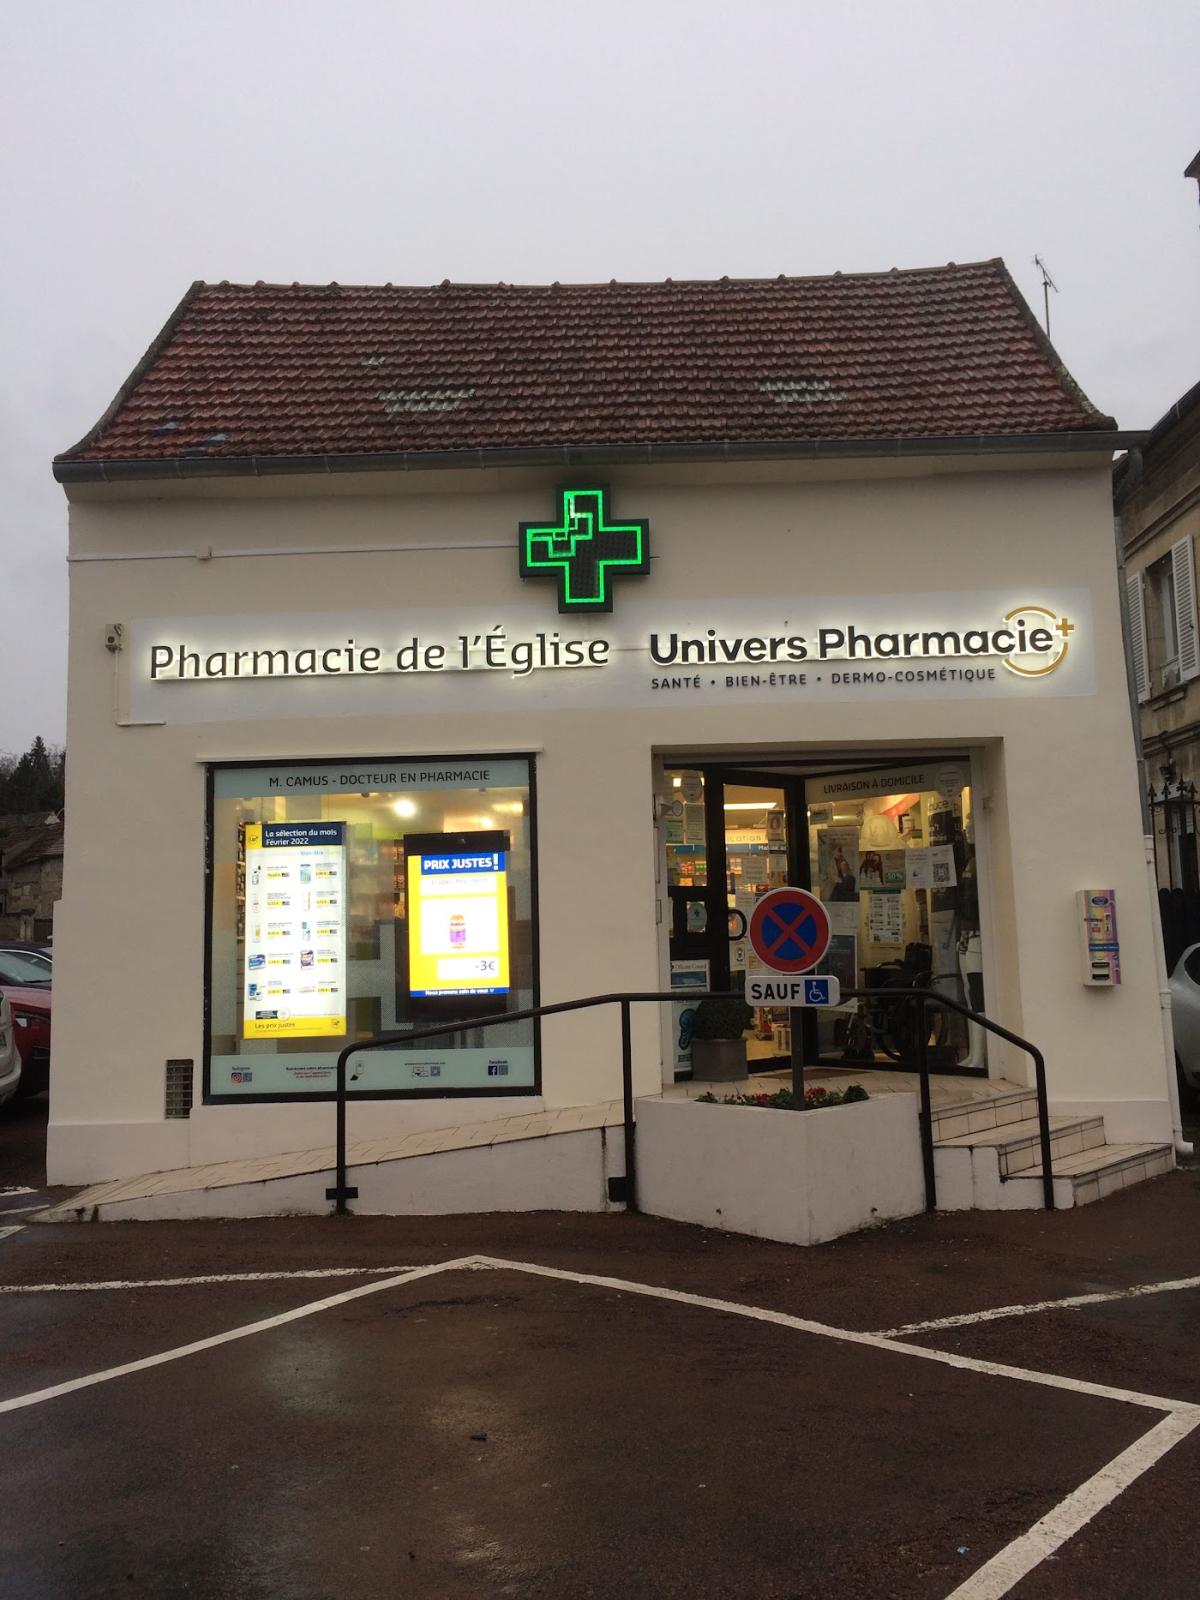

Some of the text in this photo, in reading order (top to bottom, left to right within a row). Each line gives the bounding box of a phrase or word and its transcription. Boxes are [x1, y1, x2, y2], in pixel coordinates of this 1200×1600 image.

[650, 619, 1054, 664] Univers Pharmacie
[151, 625, 610, 678] Pharmacie de l'Église
[651, 667, 996, 690] SANTÉ BIEN-ÊTRE DERMO-COSMÉTIQUE
[269, 769, 491, 788] M. CAMUS DOCTEUR EN PHARMACIE
[823, 781, 870, 794] LIVRAISON
[872, 779, 879, 789] À
[880, 774, 925, 788] DOMICILE
[265, 828, 338, 838] La sélection du mois
[265, 837, 290, 846] Février
[290, 837, 309, 845] 2022
[423, 859, 450, 870] PRIX
[751, 984, 800, 1000] SAUF
